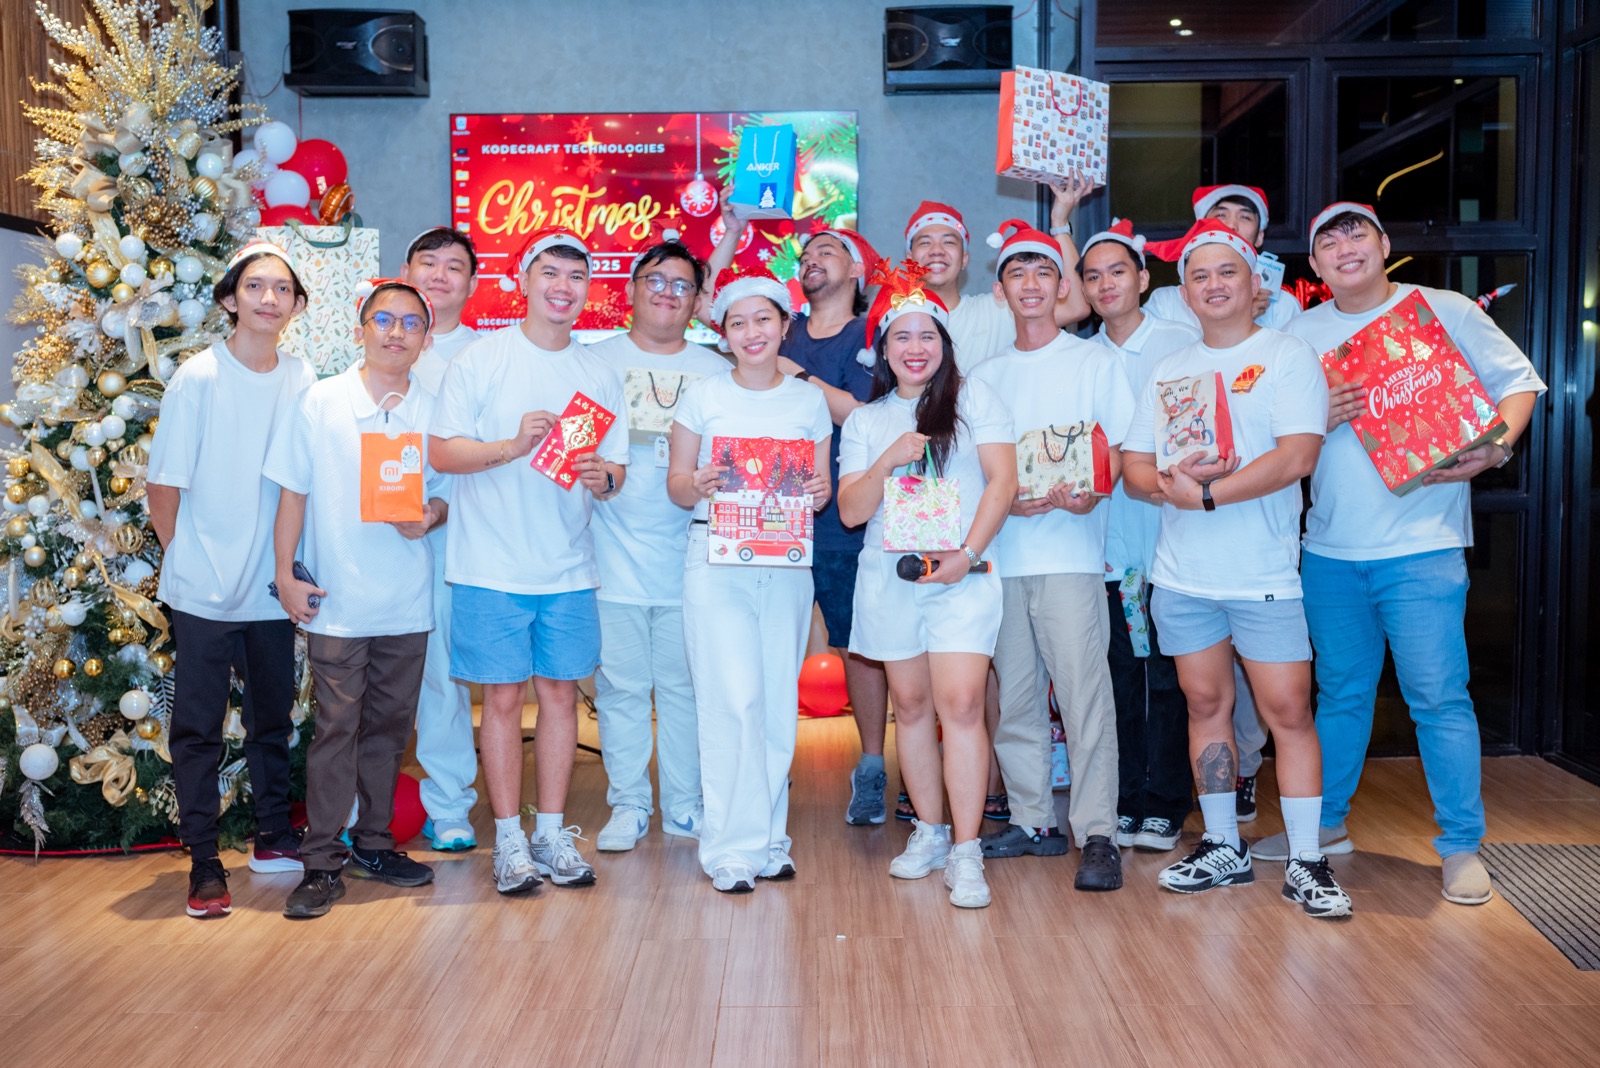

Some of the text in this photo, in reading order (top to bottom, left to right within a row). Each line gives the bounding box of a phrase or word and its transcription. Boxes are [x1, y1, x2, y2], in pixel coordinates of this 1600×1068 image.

[481, 143, 666, 155] KODECRAFT TECHNOLOGIES
[745, 162, 780, 172] ANKER
[478, 179, 661, 240] Christmas
[591, 259, 622, 272] 025
[1383, 362, 1426, 391] MERRY
[1368, 363, 1443, 420] Christmas
